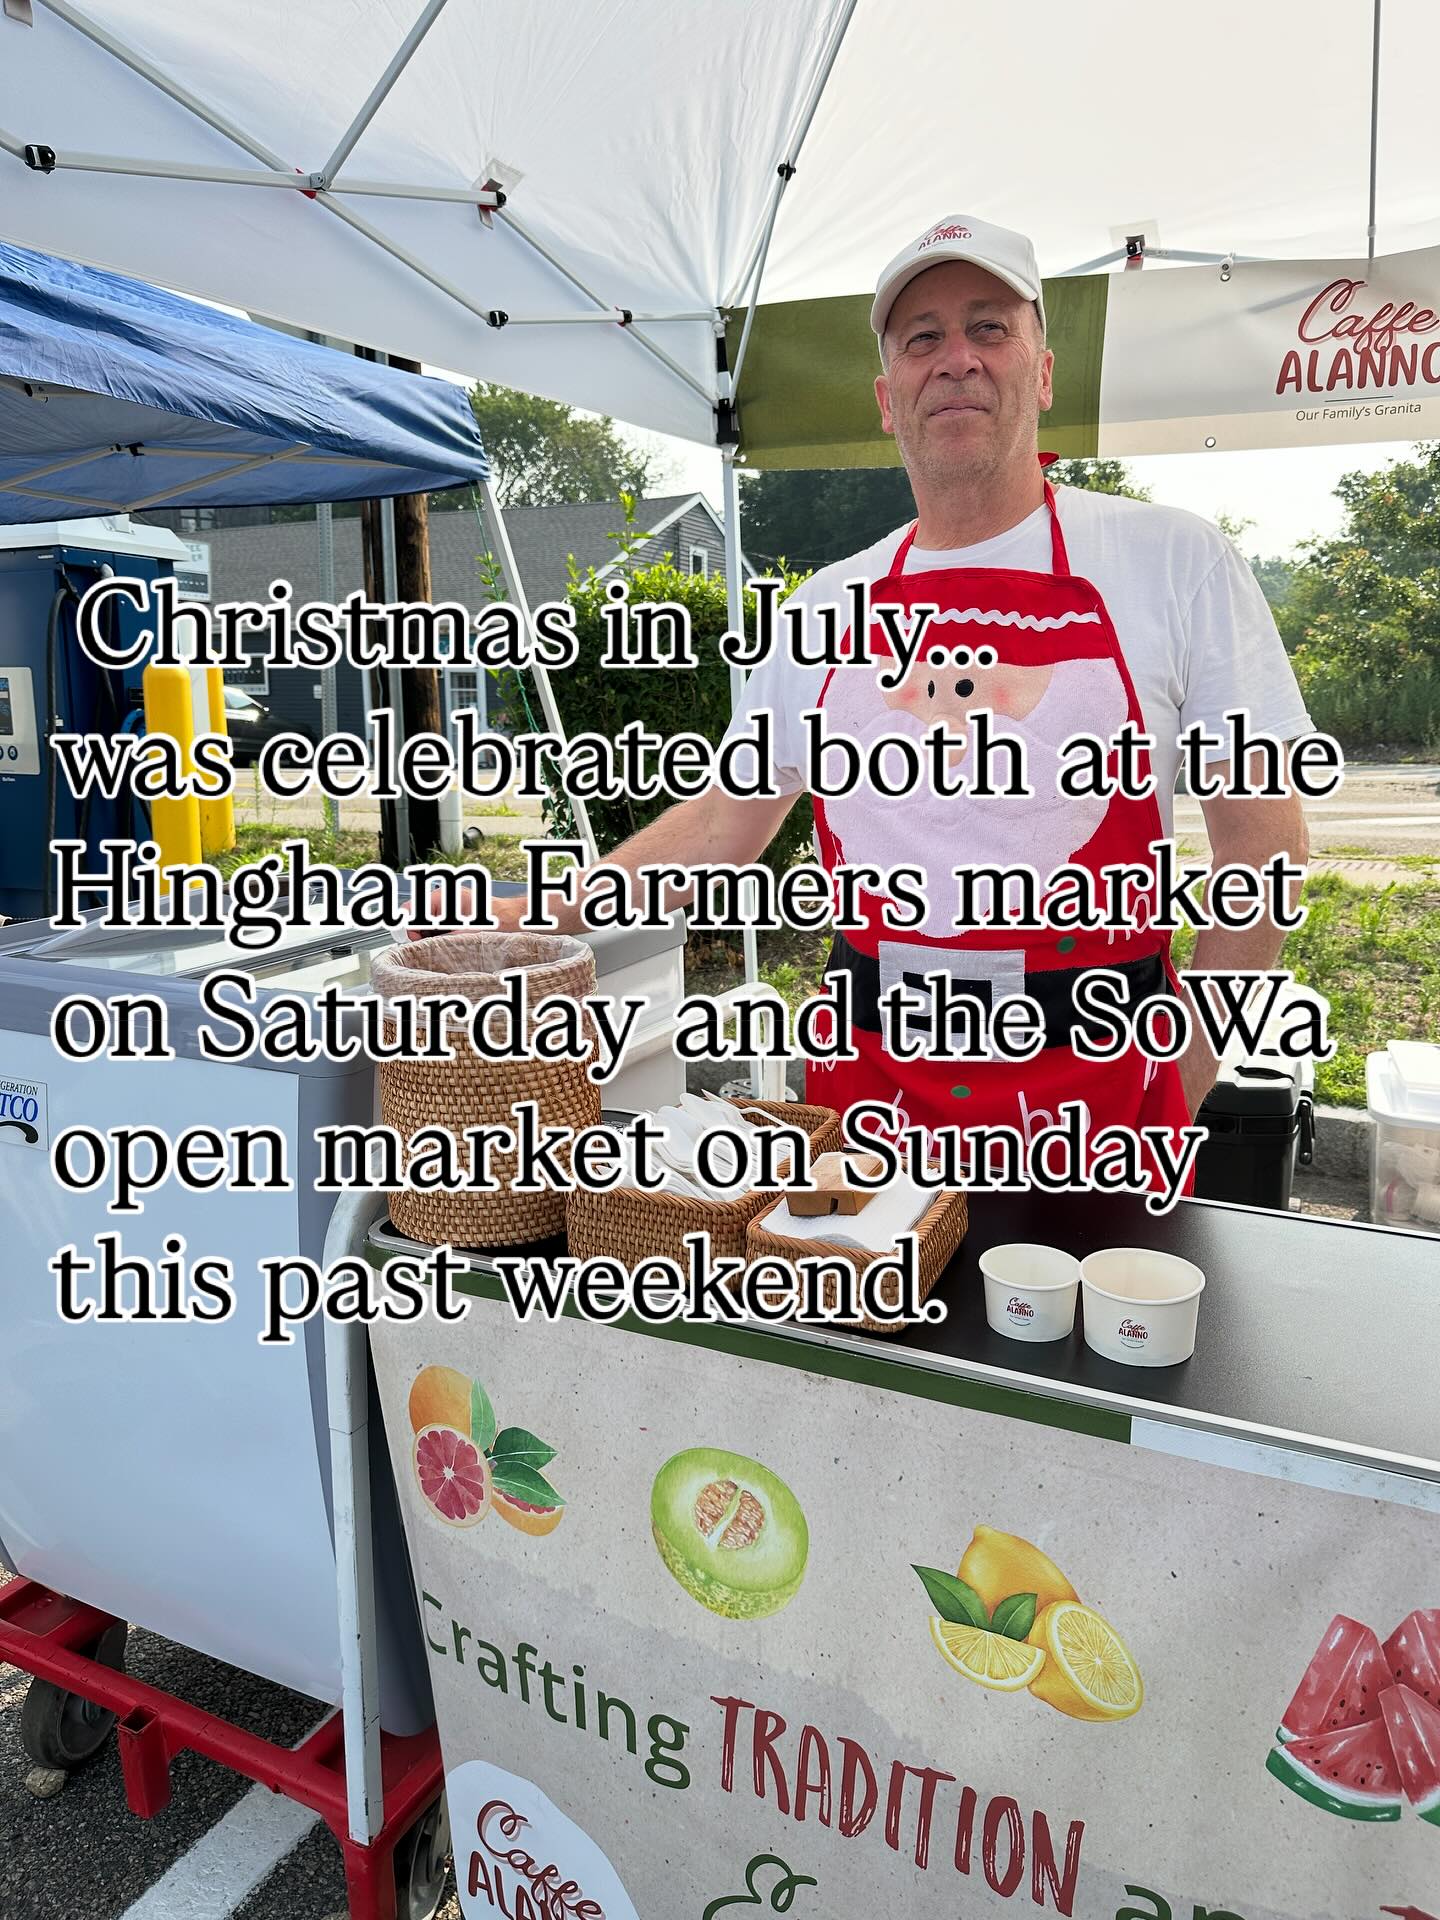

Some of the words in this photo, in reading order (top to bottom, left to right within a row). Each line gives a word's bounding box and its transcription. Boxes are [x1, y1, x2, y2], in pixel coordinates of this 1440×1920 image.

[917, 232, 973, 252] ALANNO
[1297, 278, 1440, 354] Caffe
[1295, 410, 1319, 421] Our
[1322, 406, 1371, 421] Family's
[1374, 402, 1422, 416] Granita
[0, 1081, 38, 1096] GERATION
[1009, 1297, 1032, 1309] Caffe
[1006, 1305, 1034, 1317] ALANNO
[1121, 1319, 1146, 1331] Caffe
[1118, 1328, 1148, 1340] ALANNO
[709, 1695, 1086, 1918] TRADITION
